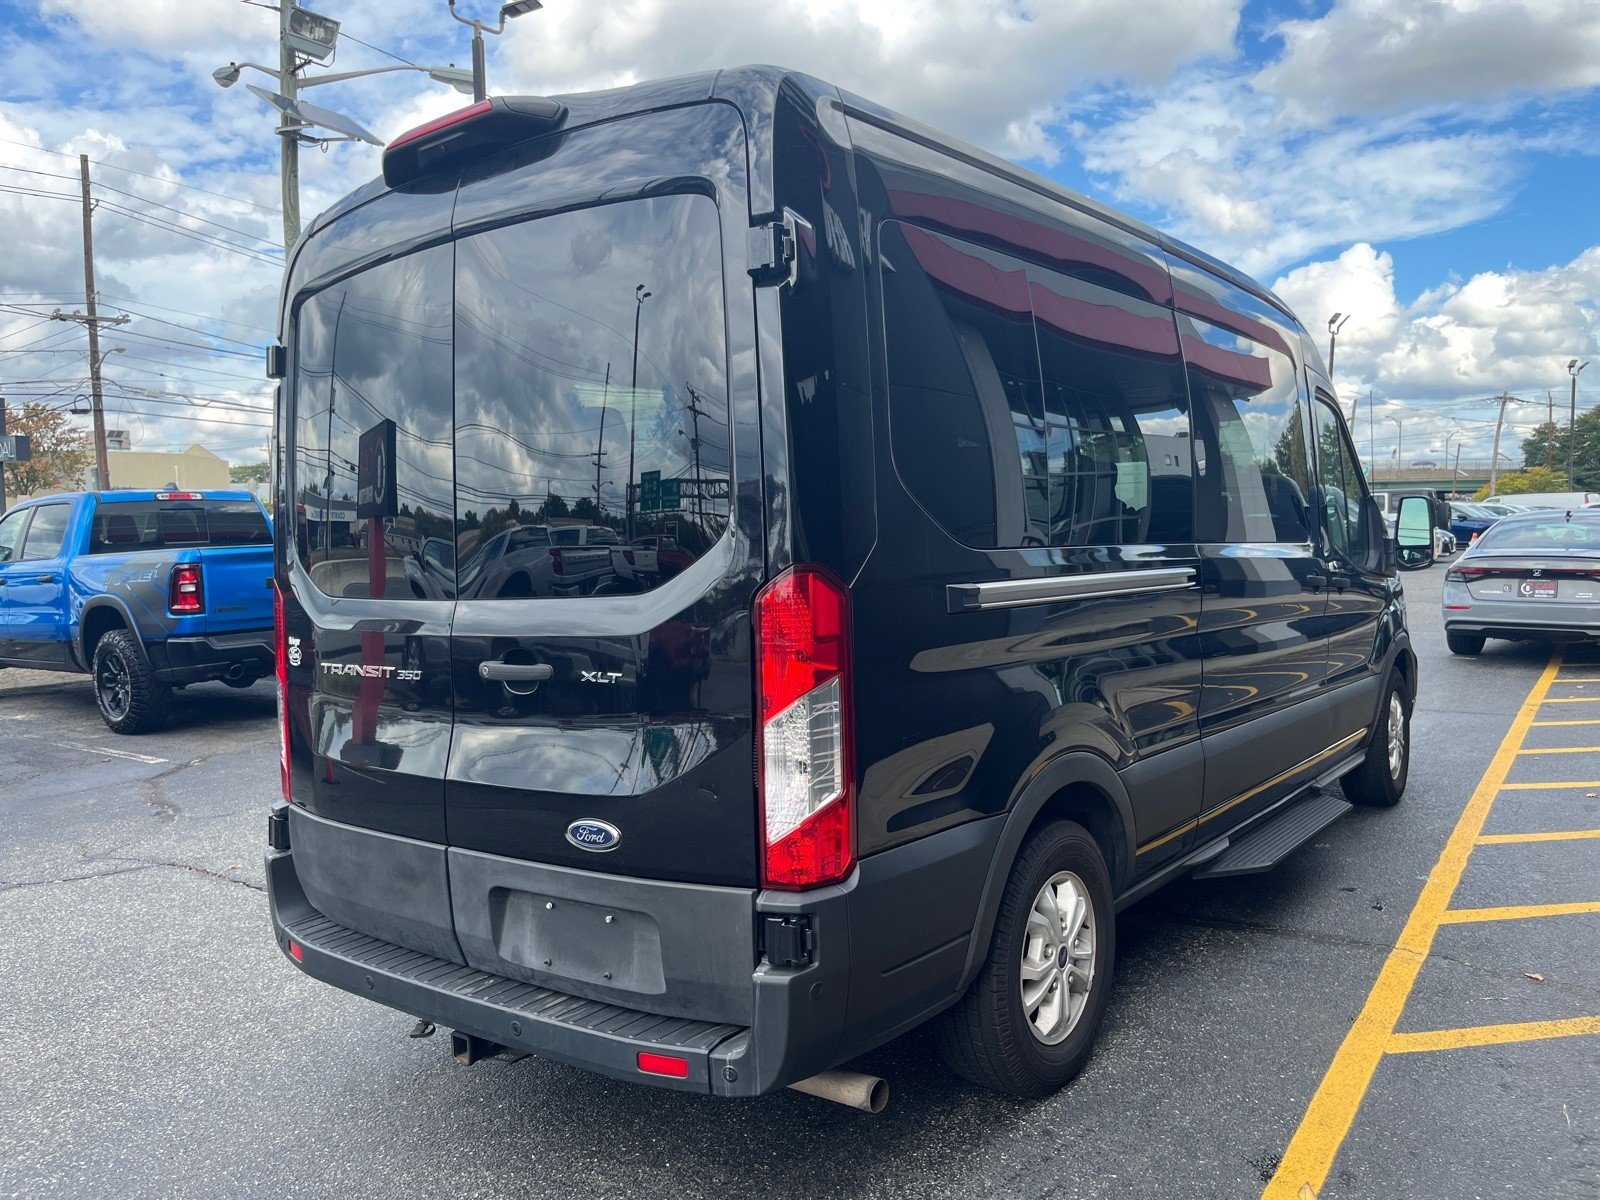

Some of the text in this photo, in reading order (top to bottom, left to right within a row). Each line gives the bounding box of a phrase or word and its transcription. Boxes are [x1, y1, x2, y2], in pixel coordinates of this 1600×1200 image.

[320, 662, 421, 680] TRANSIT 350
[580, 670, 623, 684] XLT
[576, 825, 605, 843] Ford
